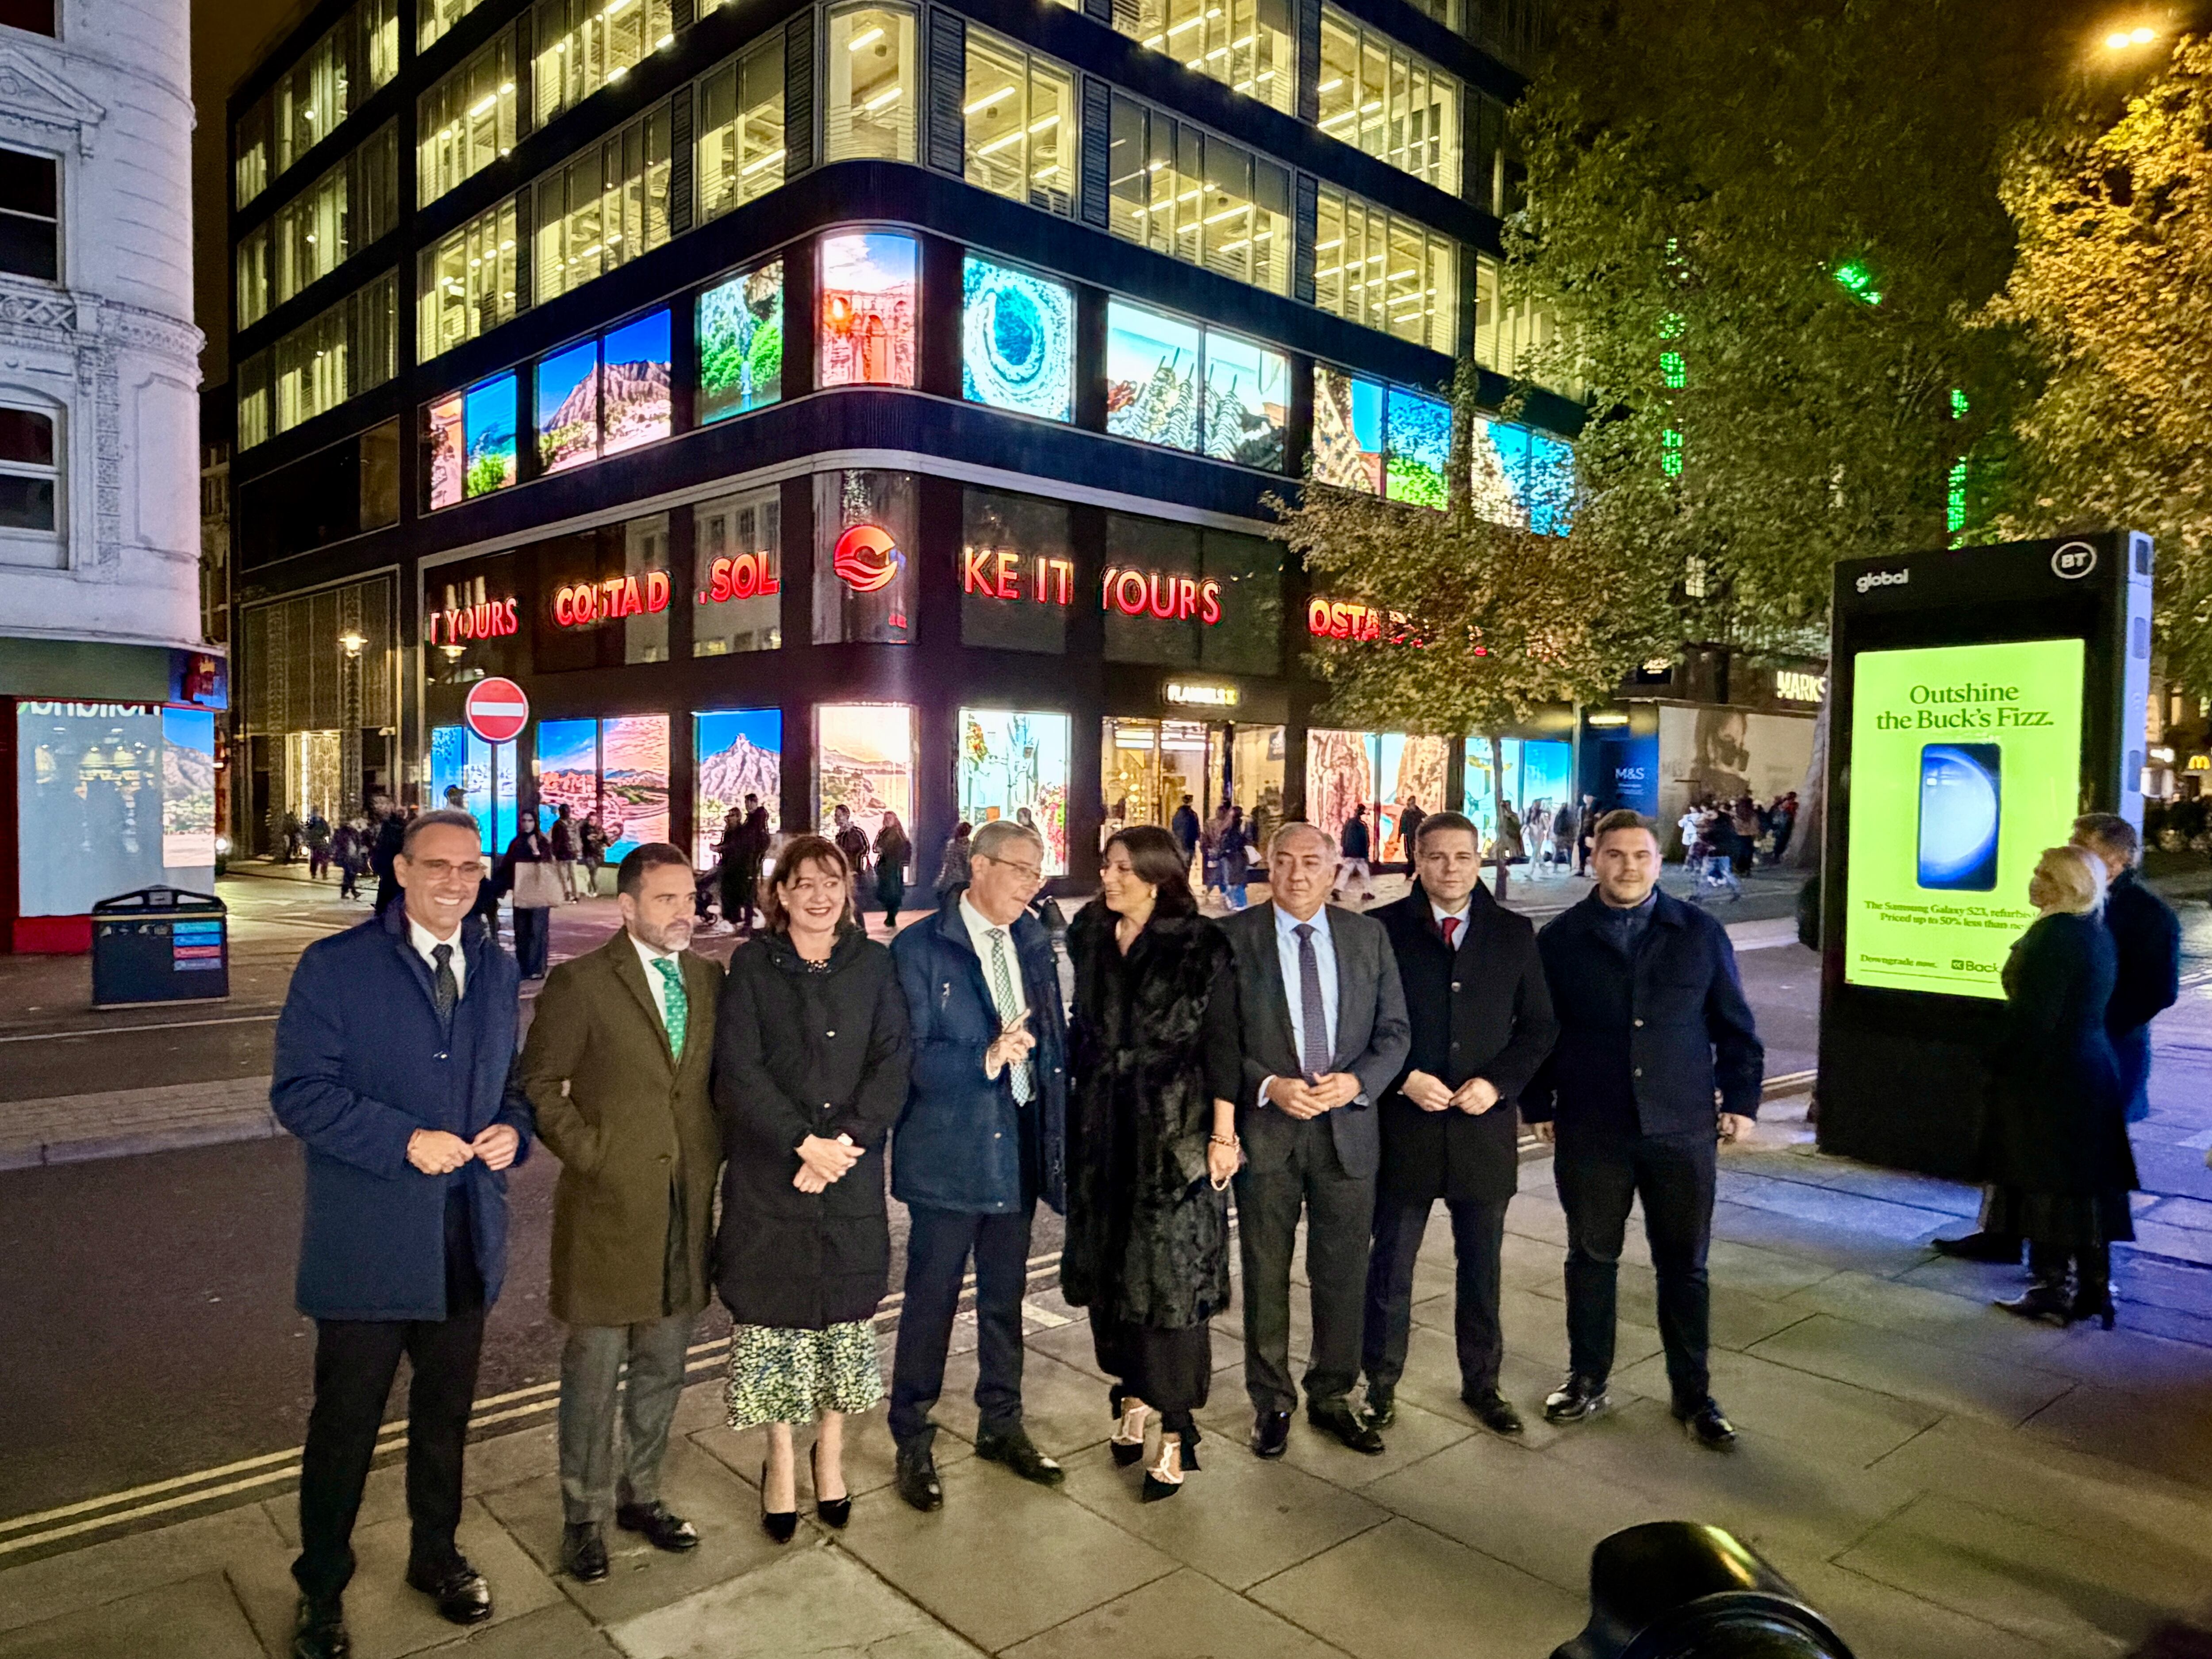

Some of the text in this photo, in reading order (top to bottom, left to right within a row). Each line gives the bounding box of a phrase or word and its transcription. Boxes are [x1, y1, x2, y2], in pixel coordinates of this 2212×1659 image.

[2062, 552, 2088, 568] BT
[1037, 557, 1068, 605] IT
[1855, 568, 1909, 593] global
[445, 597, 518, 643] YOURS
[1910, 683, 2020, 704] Outshine
[1877, 707, 2054, 730] the Buck's Fizz.
[1615, 767, 1645, 780] M&S
[1864, 900, 1883, 910] The
[1885, 902, 1929, 914] Samsung
[1930, 904, 1964, 917] Galaxy
[1880, 912, 1912, 923] Priced
[1913, 917, 1927, 926] up
[1939, 916, 1962, 926] 50%
[1963, 918, 1982, 927] less
[1985, 920, 2008, 929] than
[1859, 954, 1914, 966] Downgrade
